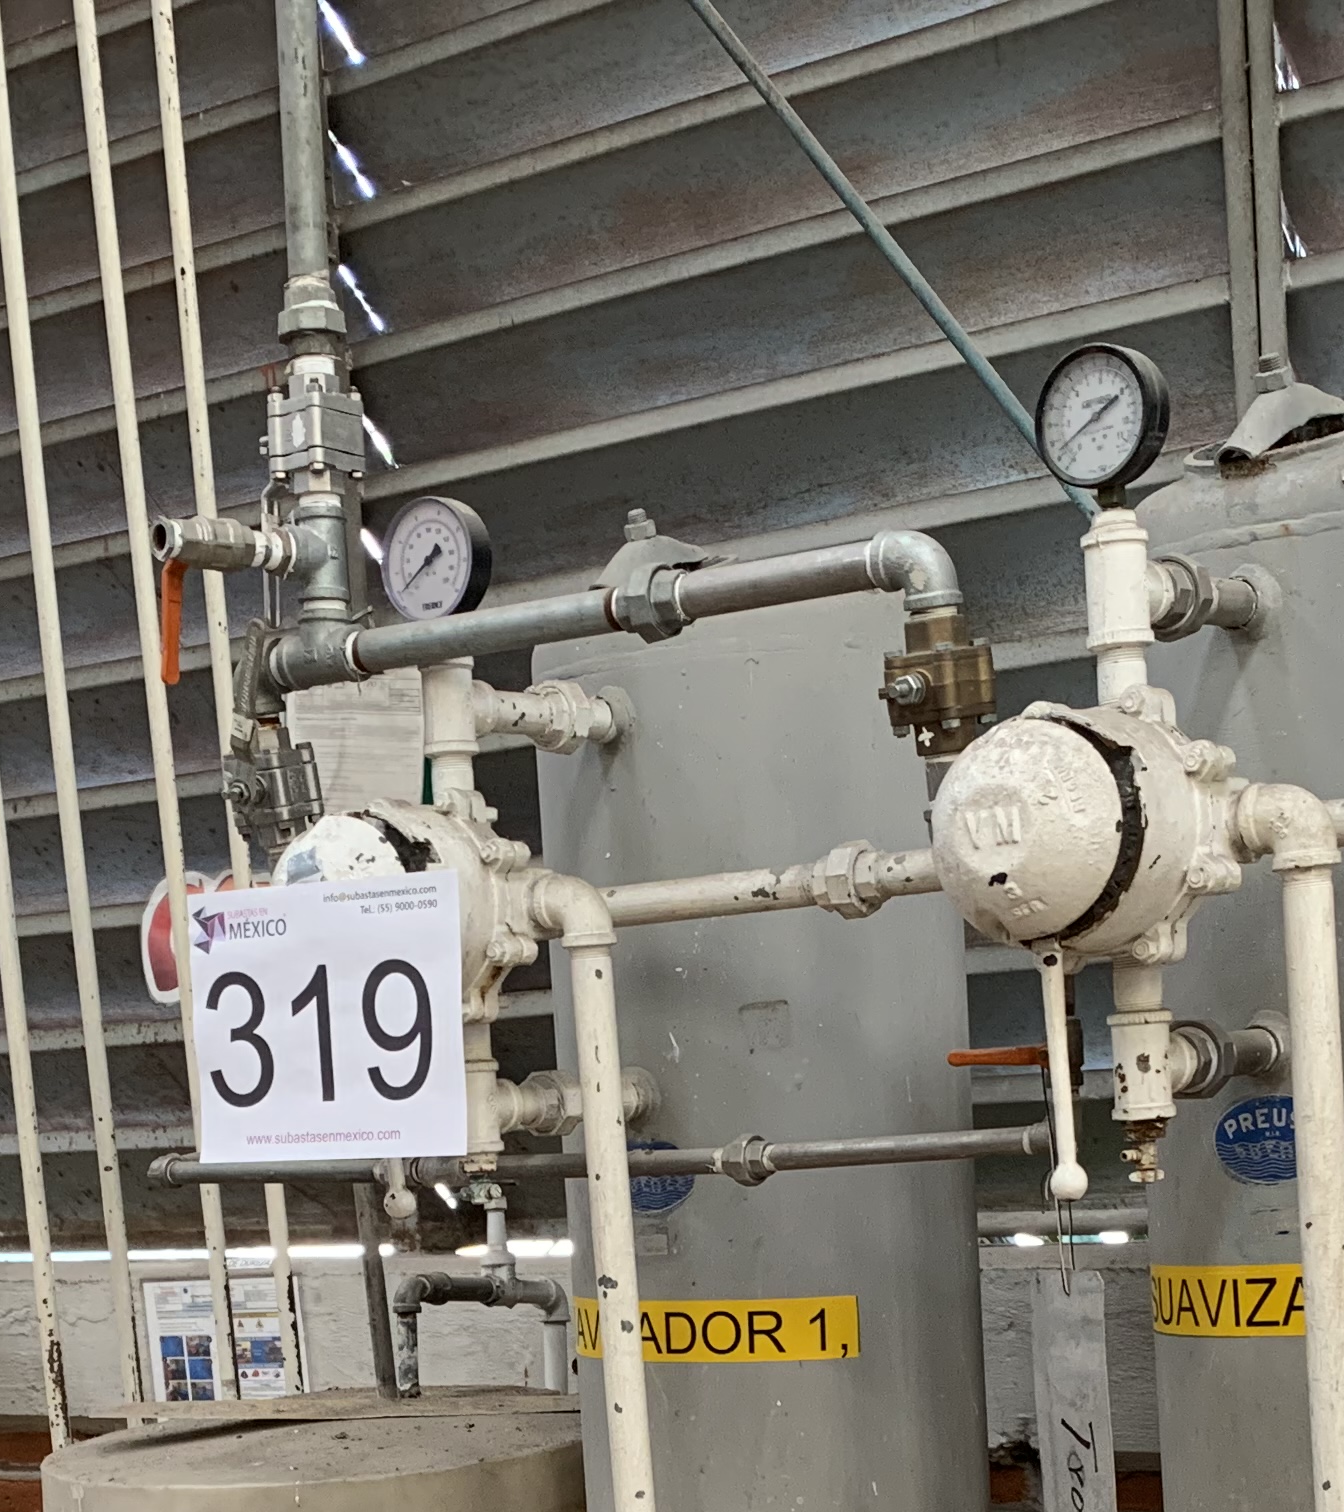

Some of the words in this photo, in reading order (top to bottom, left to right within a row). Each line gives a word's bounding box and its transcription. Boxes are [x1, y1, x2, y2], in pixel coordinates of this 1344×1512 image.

[323, 885, 437, 903] info@subastasenmexico.com
[227, 908, 258, 920] SUBASTAS
[259, 908, 268, 917] EN
[377, 903, 393, 914] (55)
[229, 918, 287, 940] MÉXICO
[205, 958, 433, 1108] 319
[246, 1128, 401, 1146] www.subastasenmexico.com
[577, 1307, 787, 1356] AVADOR
[809, 1308, 849, 1358] 1,
